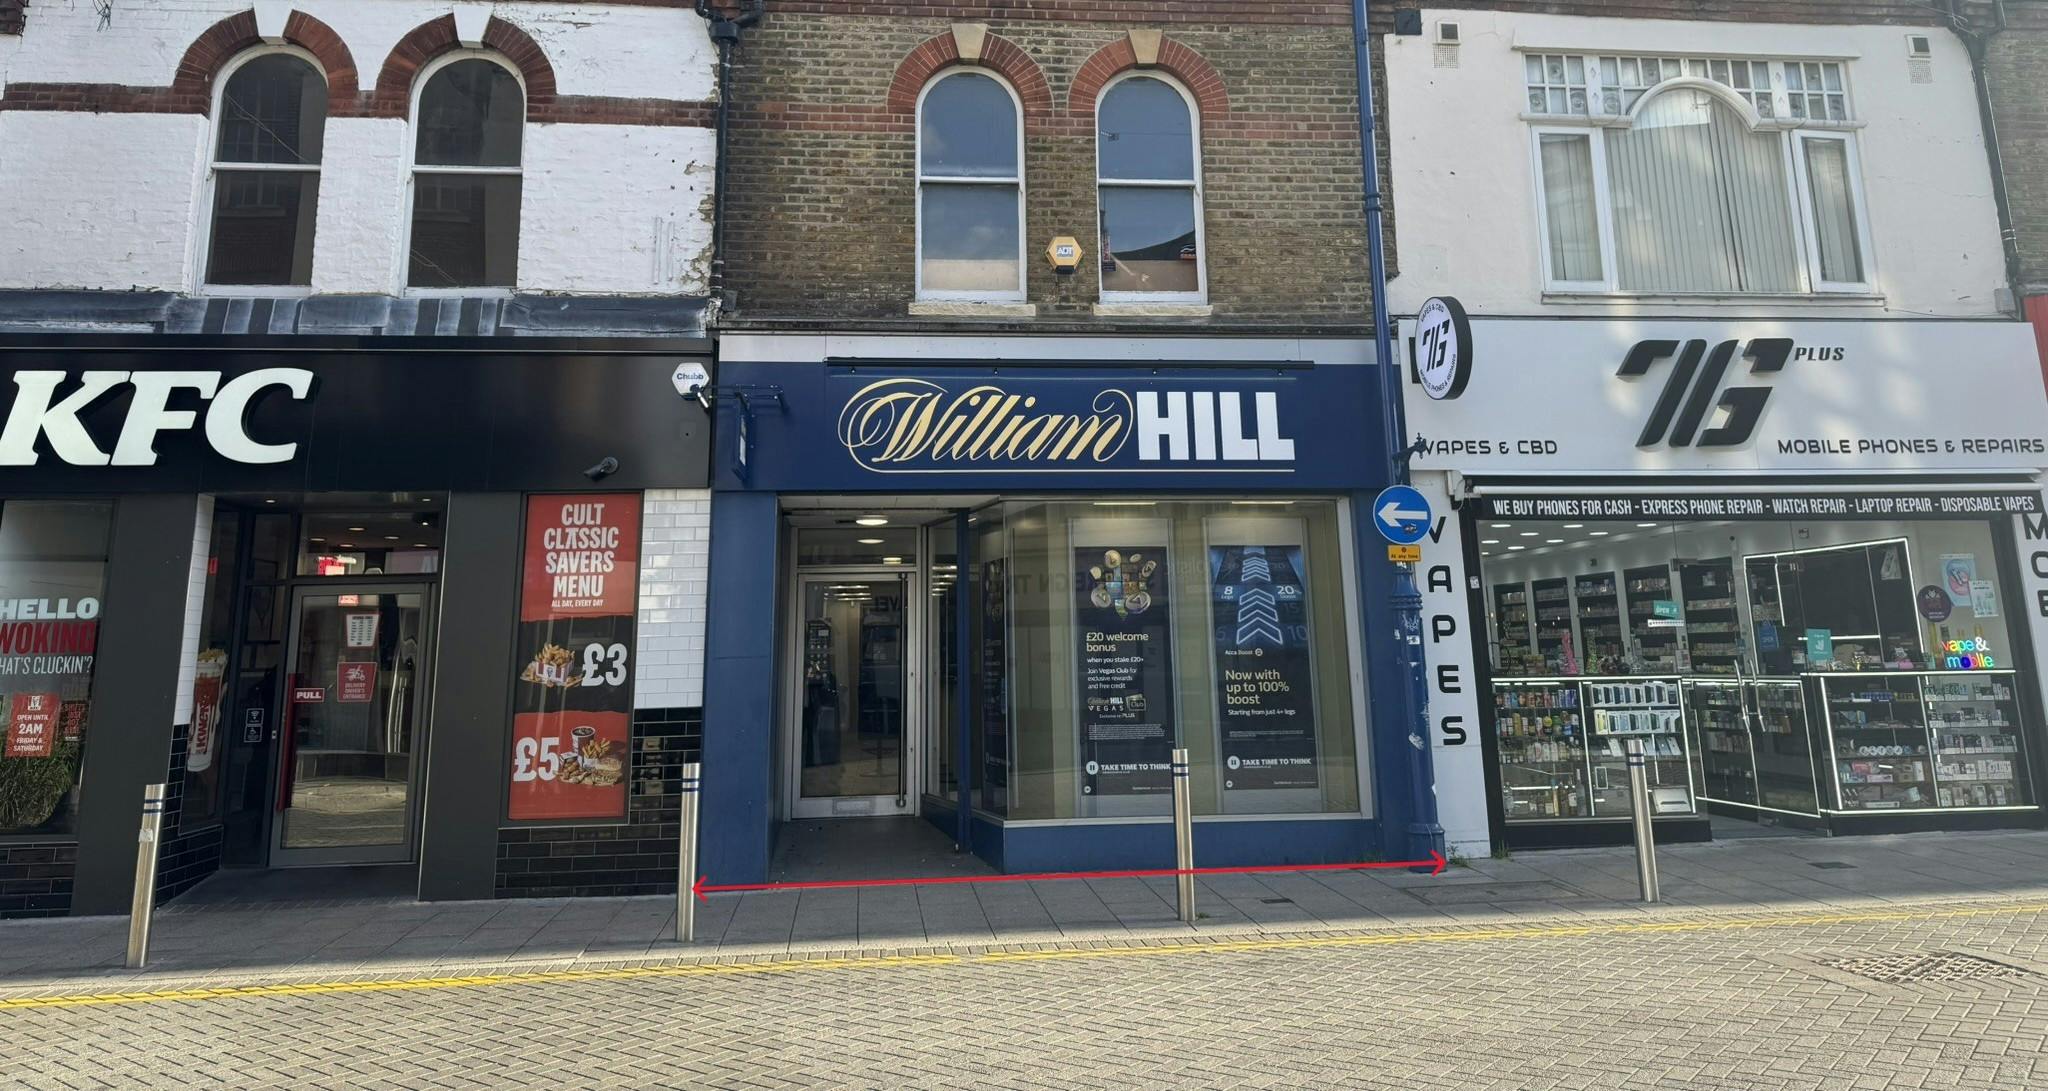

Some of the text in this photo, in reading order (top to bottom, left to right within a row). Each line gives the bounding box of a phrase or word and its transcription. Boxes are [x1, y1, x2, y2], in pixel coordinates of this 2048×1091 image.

[1056, 246, 1074, 256] ADT
[1794, 347, 1845, 361] PLUS
[676, 372, 704, 380] Chubb
[0, 367, 314, 466] KFC
[838, 378, 1296, 463] William HILL
[1425, 440, 1557, 455] VAPES & CBD
[1777, 438, 2046, 455] MOBILE PHONES & REPAIRS
[1493, 500, 1510, 515] WE
[1513, 500, 1534, 515] BUY
[1537, 500, 1579, 515] PHONES
[1582, 500, 1602, 515] FOR
[1604, 500, 1632, 515] CASH
[1642, 500, 1689, 515] EXPRESS
[1690, 500, 1726, 515] PHONE
[1727, 499, 1764, 514] REPAIR
[1772, 499, 1809, 514] WATCH
[1810, 499, 1848, 514] REPAIR
[1856, 498, 1894, 513] LAPTOP
[1896, 498, 1933, 513] REPAIR
[1941, 497, 2002, 512] DISPOSABLE
[2002, 496, 2035, 511] VAPES
[561, 503, 605, 526] CULT
[543, 527, 620, 550] CLASSIC
[545, 550, 615, 574] SAVERS
[552, 575, 604, 598] MENU
[1224, 586, 1234, 595] 8
[0, 597, 99, 620] HELLO
[575, 600, 592, 608] EVERY
[592, 600, 604, 608] DAY
[0, 621, 97, 655] WOKING
[1086, 632, 1149, 642] £20 welcome
[1428, 516, 1468, 746] VAPES
[1086, 642, 1117, 652] bonus
[1942, 636, 1991, 655] vape &
[0, 655, 94, 675] HAT'S CLUCKIN'?
[581, 643, 628, 686] £3
[1946, 652, 1994, 668] mobile
[1225, 669, 1280, 680] Now with
[296, 691, 322, 700] PULL
[1226, 681, 1290, 694] up to 100%
[1227, 693, 1261, 705] boost
[18, 723, 43, 735] 2AM
[513, 736, 560, 782] £5
